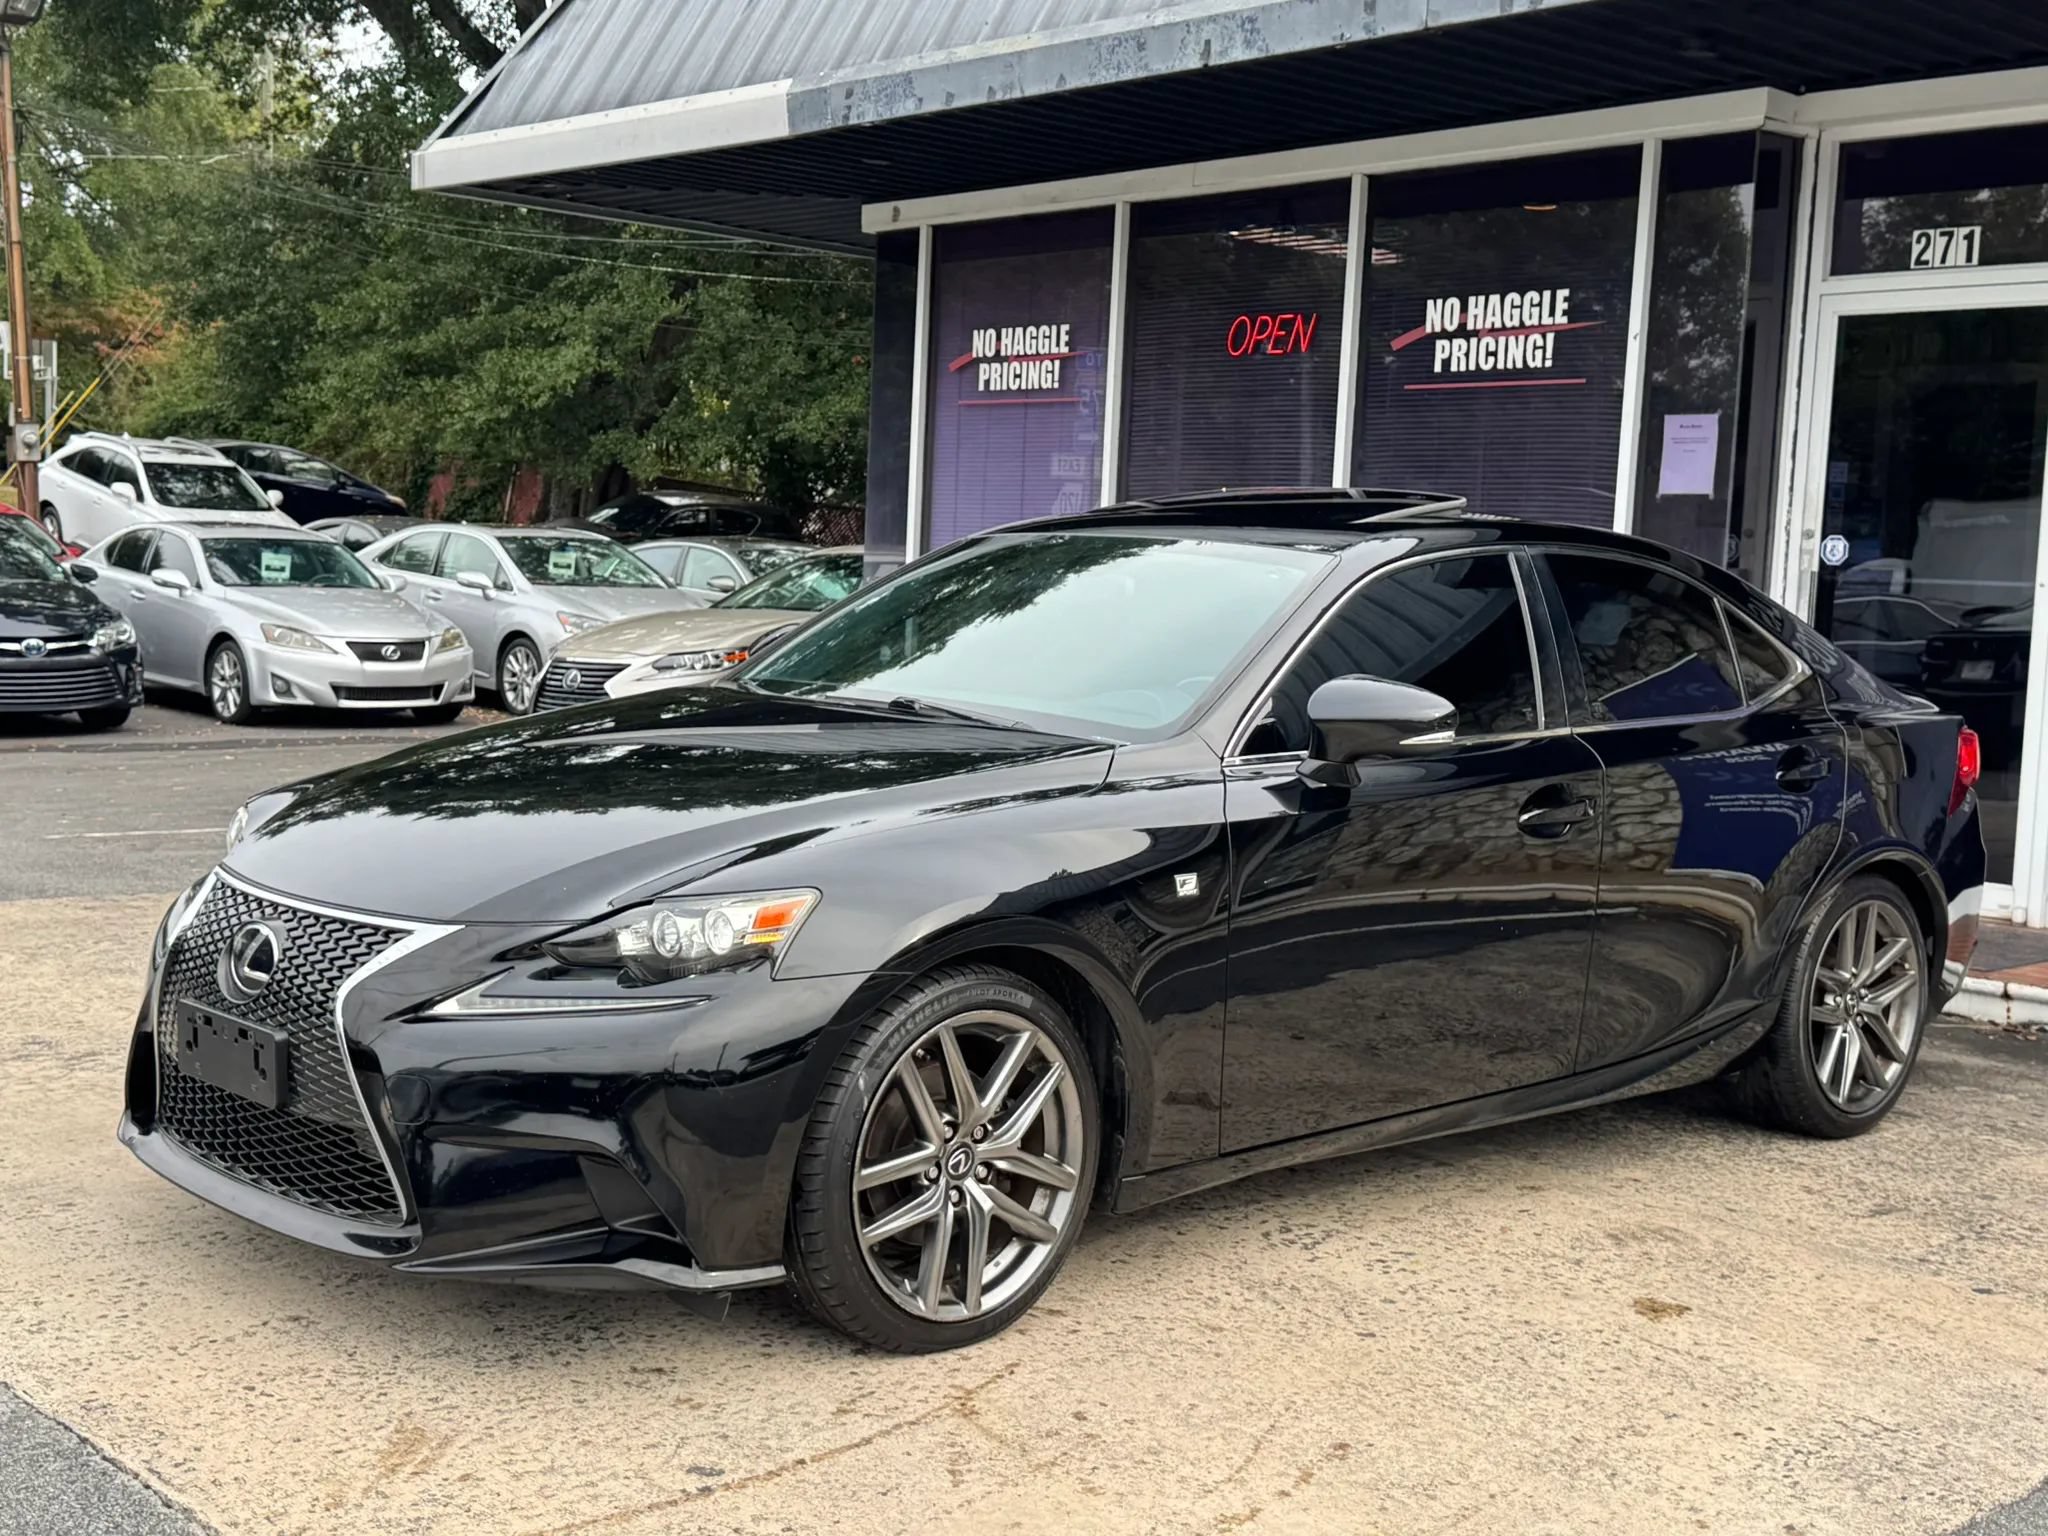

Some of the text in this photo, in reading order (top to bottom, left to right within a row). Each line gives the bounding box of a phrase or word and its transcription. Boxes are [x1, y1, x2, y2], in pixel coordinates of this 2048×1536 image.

[1913, 228, 1975, 267] 271
[1425, 288, 1570, 334] NO HAGGLE
[972, 324, 1070, 358] NO HAGGLE
[1227, 312, 1317, 356] OPEN
[1433, 332, 1555, 373] PRICING!
[978, 360, 1060, 391] PRICING!
